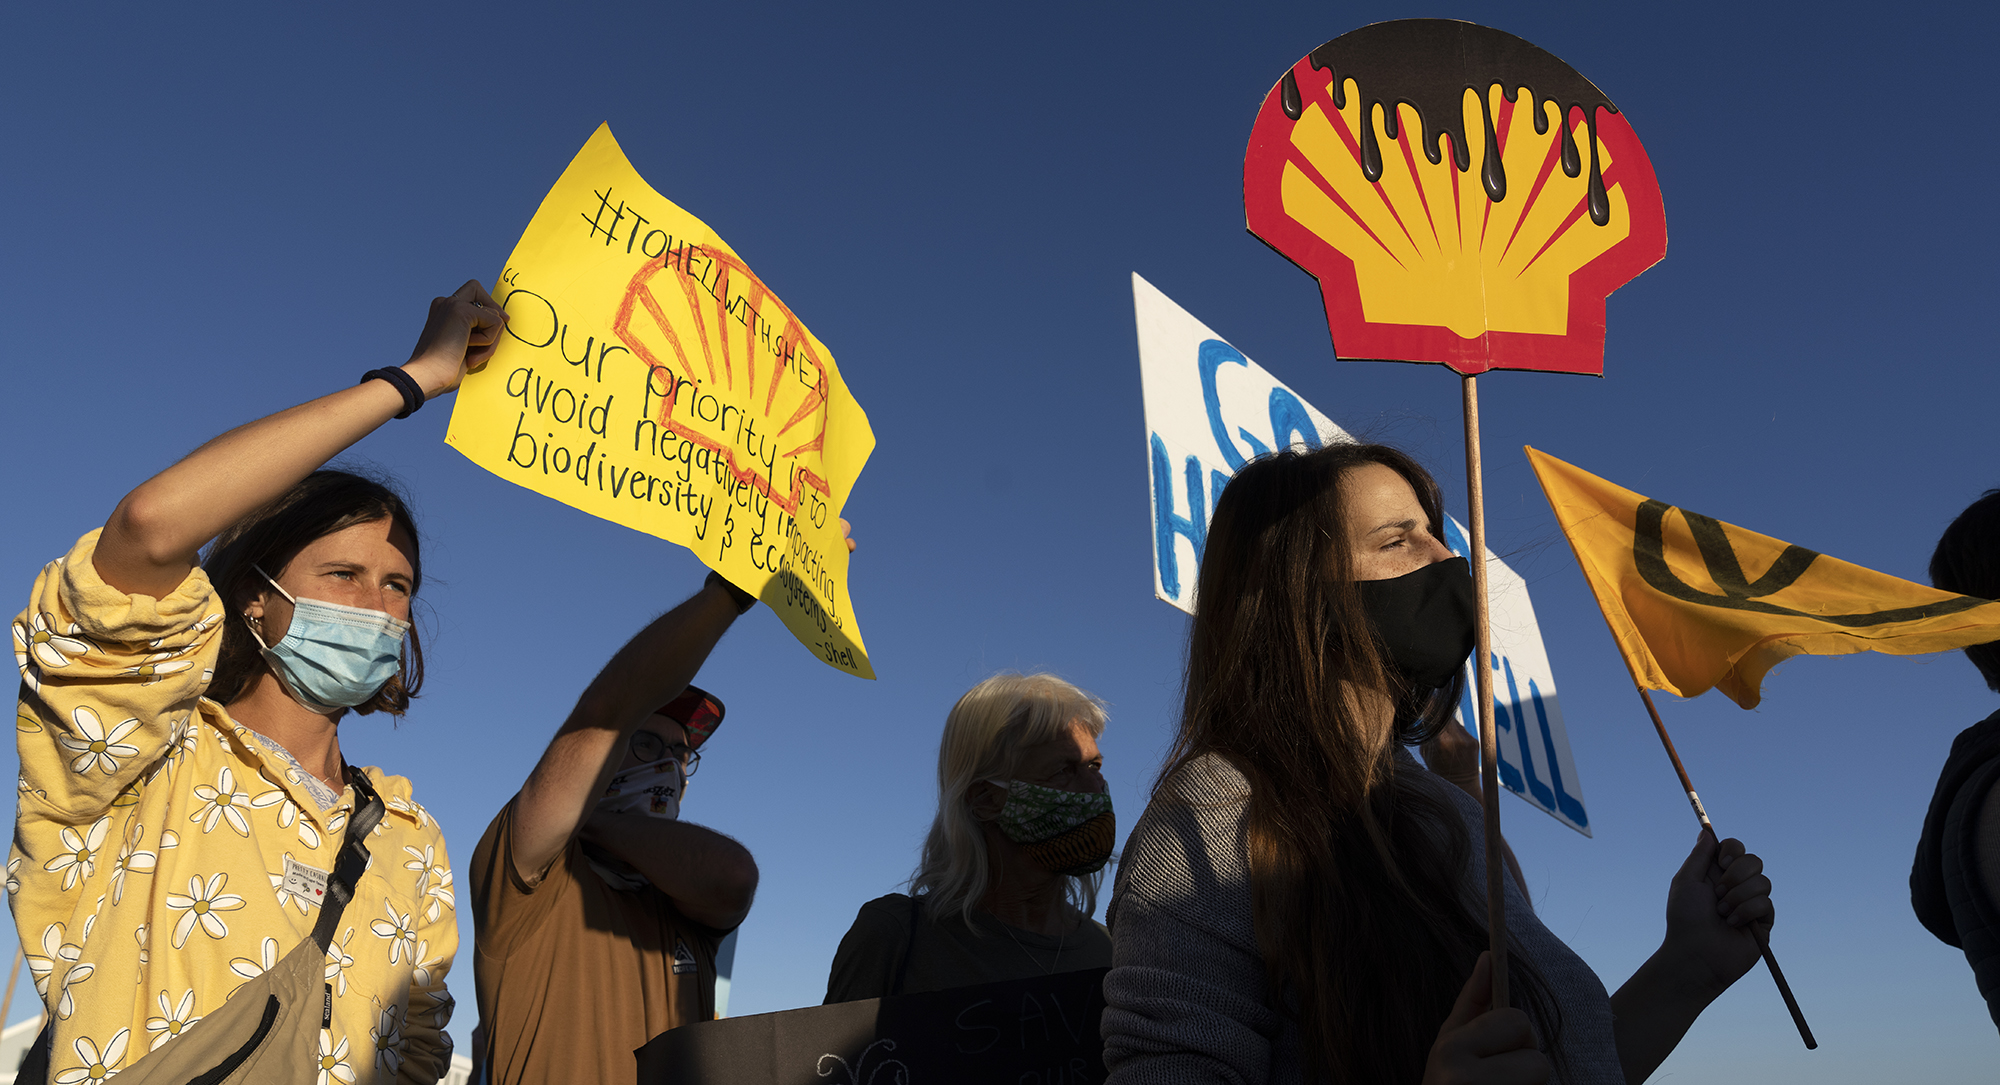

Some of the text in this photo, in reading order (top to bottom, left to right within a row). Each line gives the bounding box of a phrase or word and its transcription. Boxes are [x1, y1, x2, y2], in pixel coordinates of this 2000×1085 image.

[581, 187, 830, 404] #TOHELLWITHSHEL
[506, 367, 614, 439] avoid
[635, 419, 769, 537] negatively
[507, 411, 713, 540] biodiversity
[643, 363, 777, 499] priority
[789, 455, 809, 506] is
[810, 487, 827, 530] to
[954, 984, 1095, 1054] SAV
